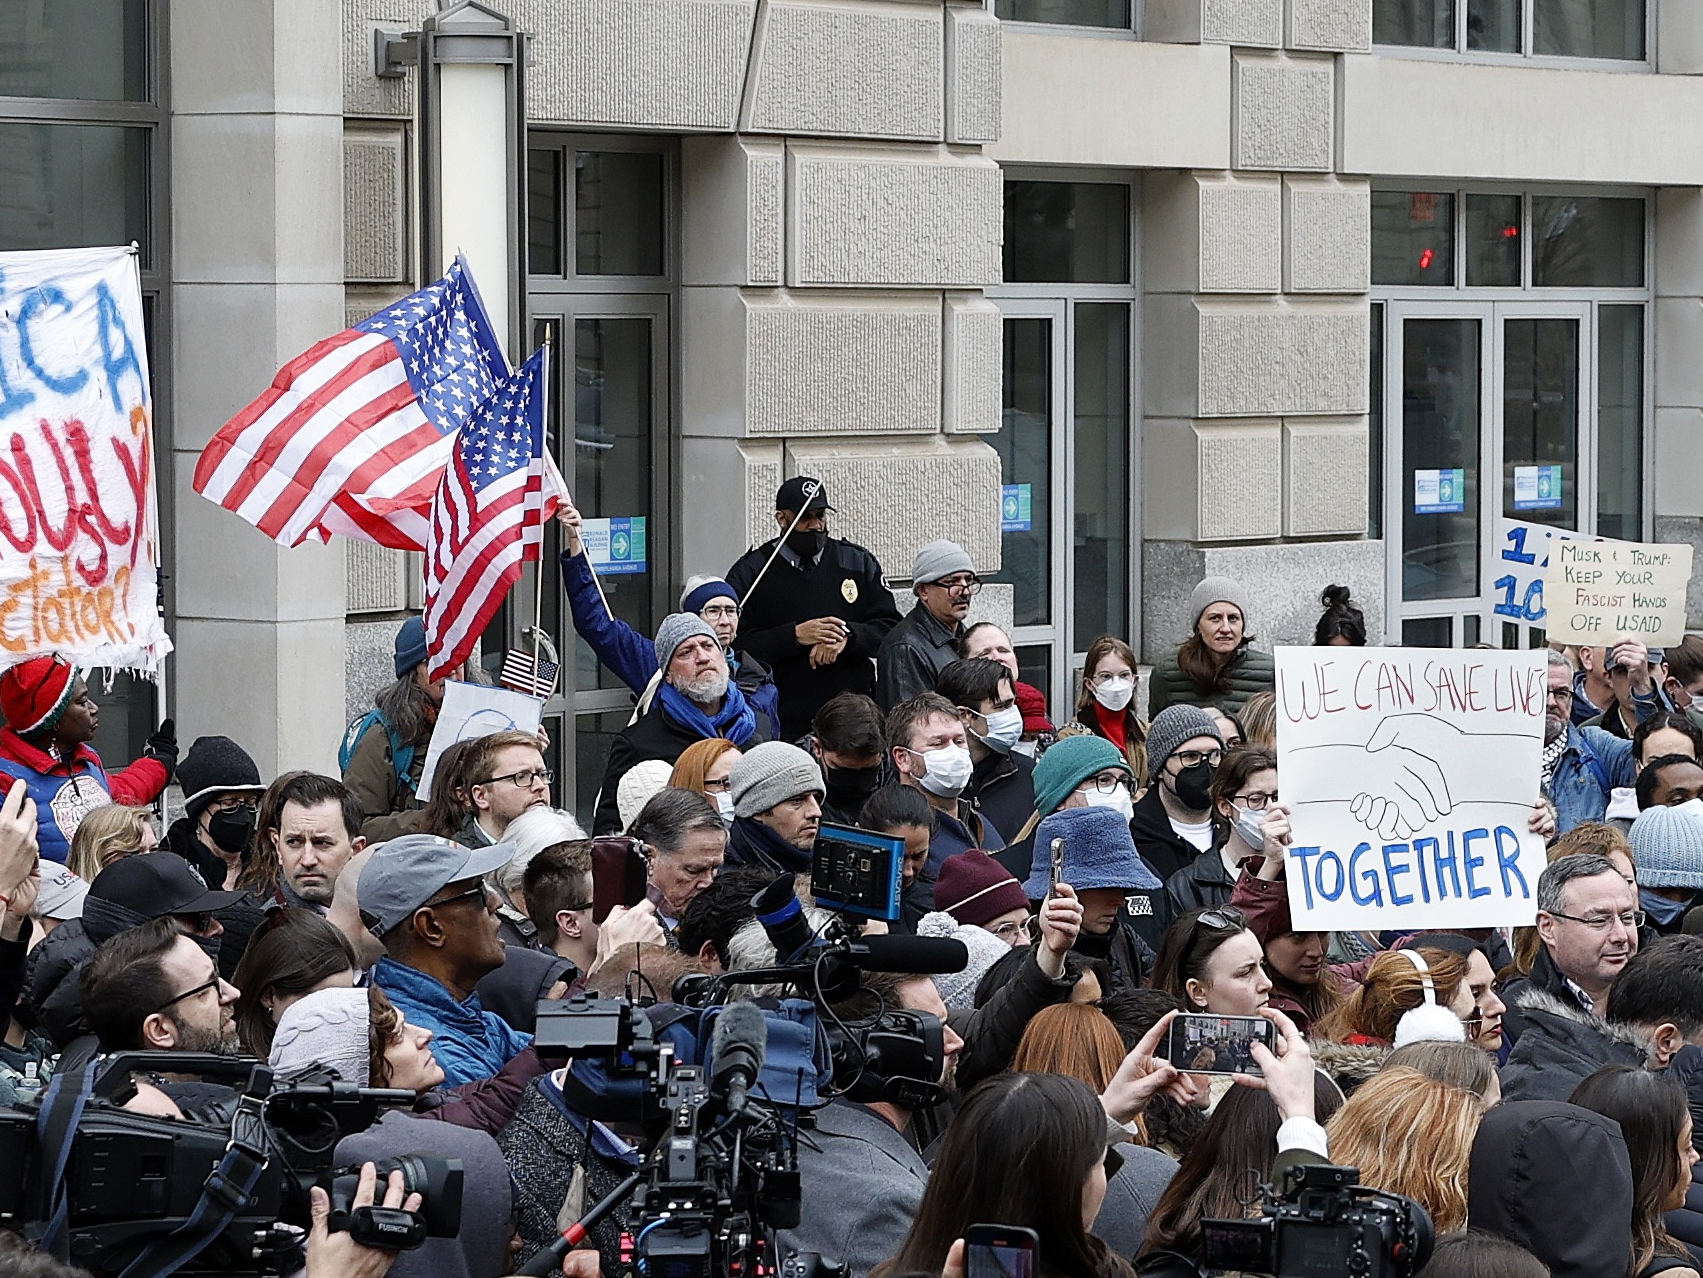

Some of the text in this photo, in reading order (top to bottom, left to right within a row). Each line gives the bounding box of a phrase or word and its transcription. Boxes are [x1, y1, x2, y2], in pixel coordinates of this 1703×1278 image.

[1565, 566, 1654, 586] KEEP YOUR
[1575, 588, 1626, 608] FASCIST
[1571, 613, 1663, 633] OFF USAID
[1281, 660, 1546, 723] WE CAN SAVE LIVES
[1289, 825, 1530, 910] TOGETHER
